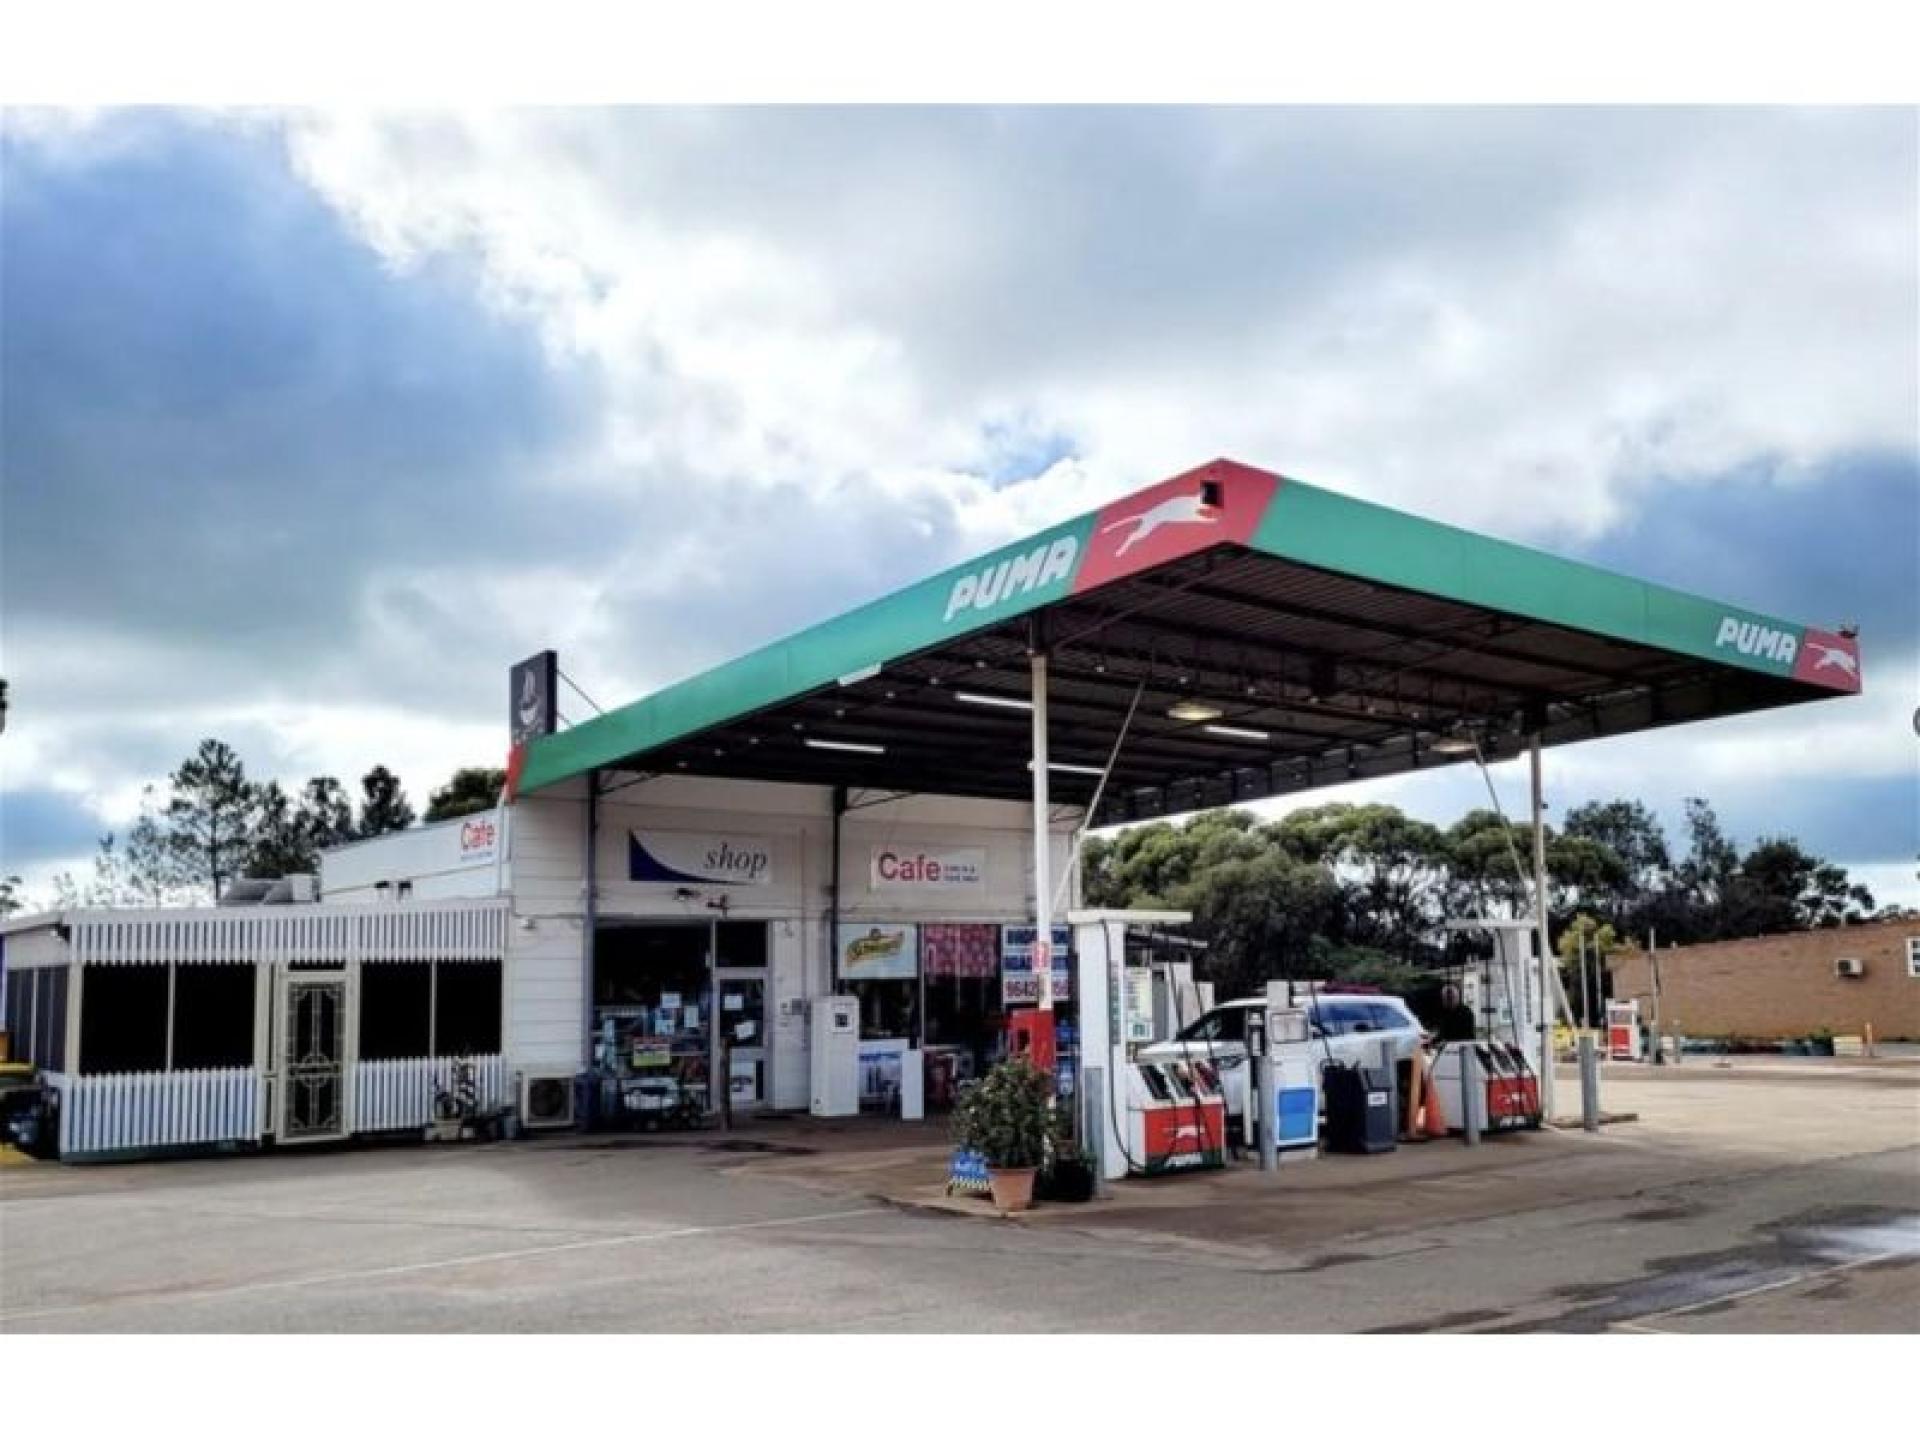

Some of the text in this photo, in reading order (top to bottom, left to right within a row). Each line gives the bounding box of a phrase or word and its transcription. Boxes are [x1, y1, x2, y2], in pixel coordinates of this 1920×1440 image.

[943, 535, 1078, 622] PUMA
[1715, 616, 1797, 665] PUMA
[703, 841, 767, 879] shop
[879, 852, 940, 882] Cafe
